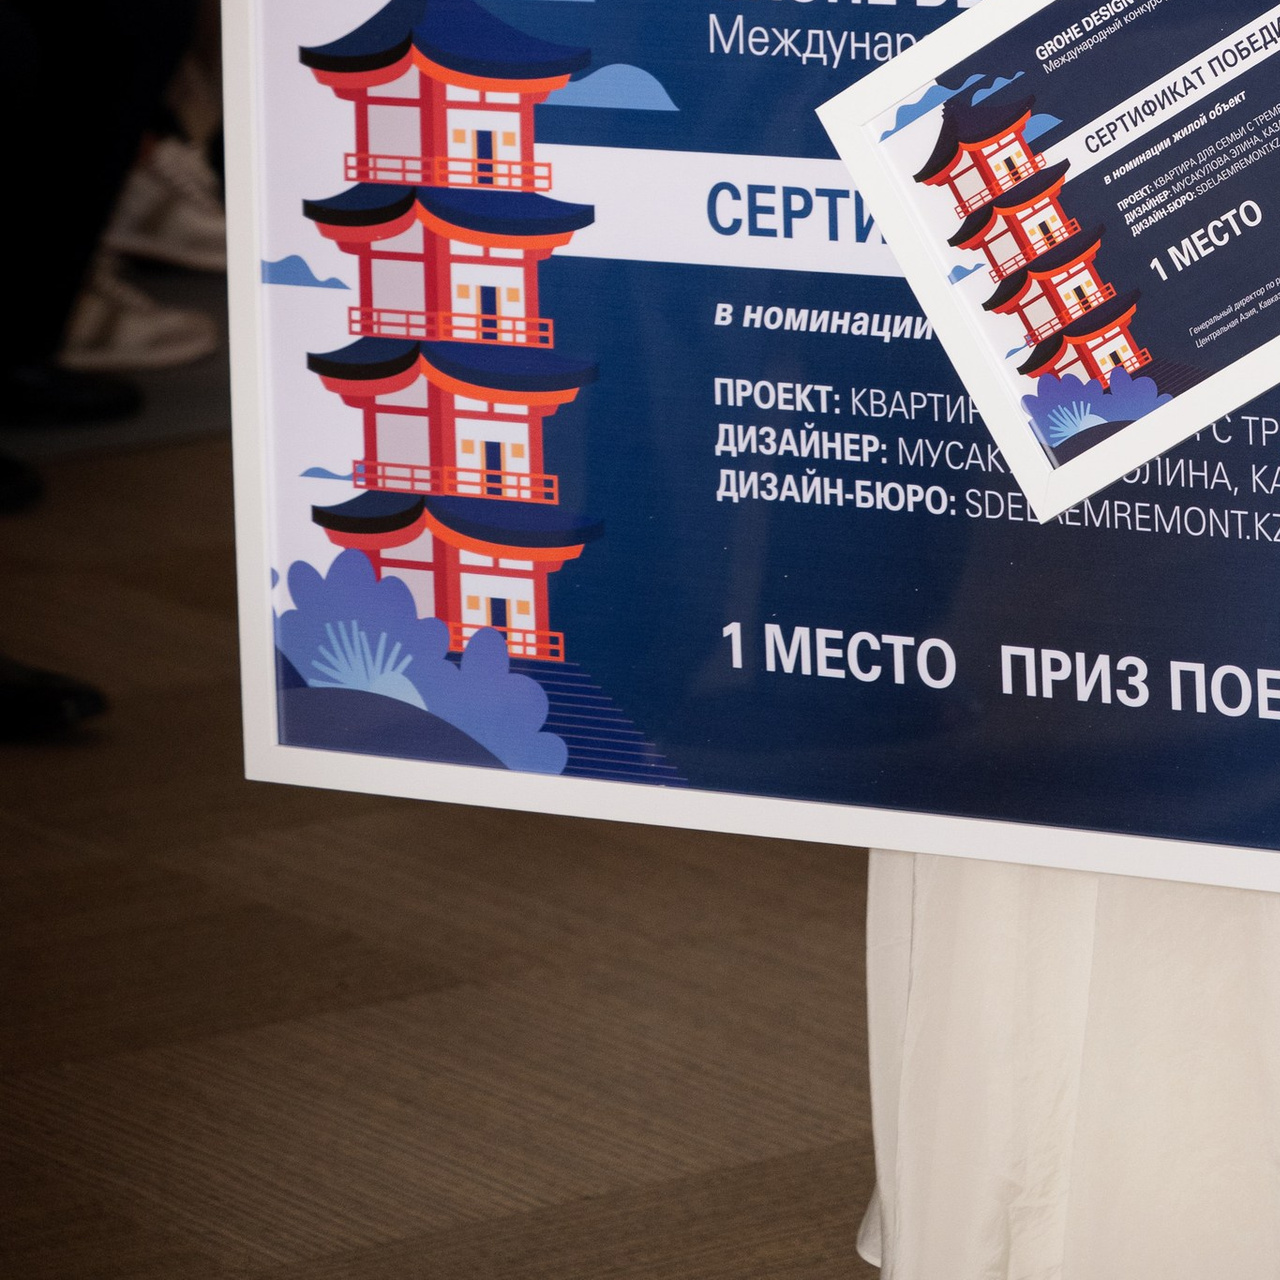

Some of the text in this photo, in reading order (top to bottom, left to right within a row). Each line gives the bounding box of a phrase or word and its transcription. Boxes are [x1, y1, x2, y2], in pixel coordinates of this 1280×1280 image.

[708, 13, 928, 68] Междунар
[1035, 22, 1084, 61] GROHE
[1042, 17, 1123, 74] Международный
[1084, 65, 1206, 154] СЕРТИФИКАТ
[1103, 90, 1246, 185] в номинации жилой объект
[1116, 184, 1155, 212] ПРОЕКТ:
[1152, 157, 1198, 190] КВАРТИРА
[1196, 145, 1217, 165] ДЛЯ
[1215, 126, 1247, 151] СЕМЬИ
[1246, 121, 1255, 132] С
[1124, 190, 1173, 226] ДИЗАЙНЕР:
[1171, 153, 1231, 194] МУСАКУЛОВА
[1229, 134, 1264, 159] ЭЛИНА,
[1130, 191, 1197, 238] ДИЗАЙН-БЮРО:
[1149, 200, 1262, 281] 1 МЕСТО
[715, 302, 934, 344] в номинации
[1188, 304, 1234, 337] Генеральный
[1233, 286, 1266, 312] директор
[1265, 281, 1275, 291] по
[1195, 318, 1240, 349] Центральная
[1239, 307, 1259, 323] Азия,
[715, 378, 840, 414] ПРОЕКТ:
[715, 424, 886, 463] ДИЗАЙНЕР:
[898, 436, 1013, 474] МУСАК
[717, 469, 955, 515] ДИЗАЙН-БЮРО:
[723, 622, 742, 668] 1
[765, 624, 956, 688] МЕСТО
[1001, 645, 1149, 707] ПРИЗ
